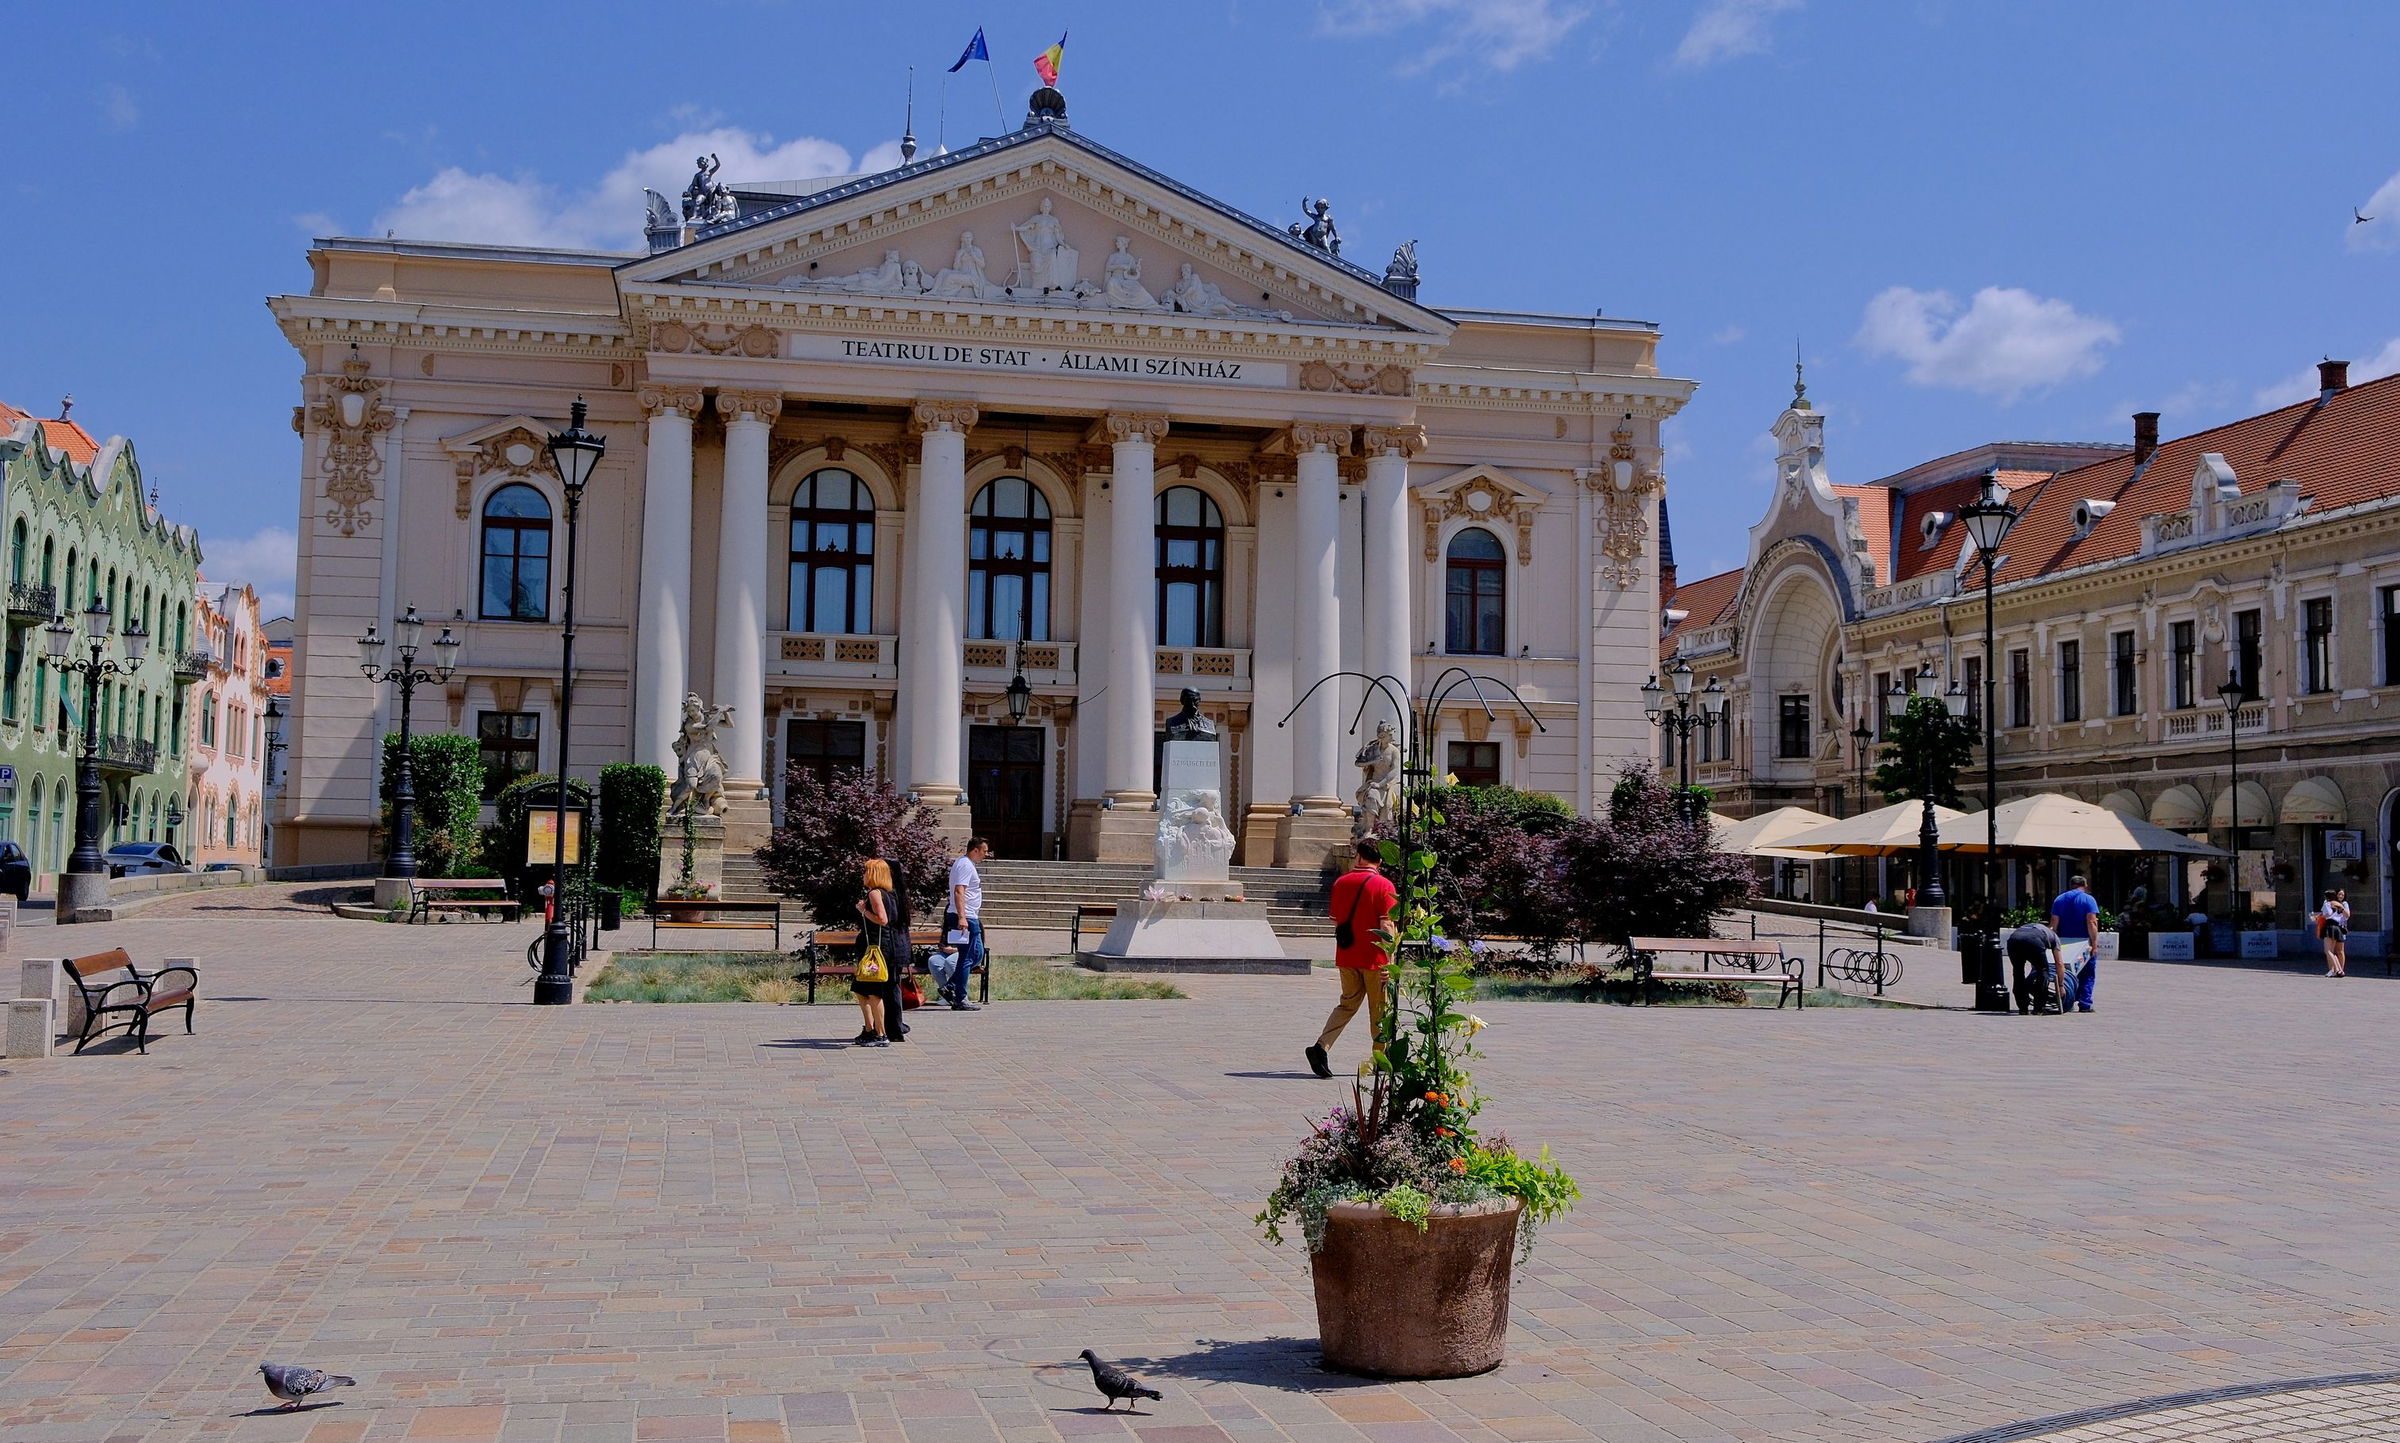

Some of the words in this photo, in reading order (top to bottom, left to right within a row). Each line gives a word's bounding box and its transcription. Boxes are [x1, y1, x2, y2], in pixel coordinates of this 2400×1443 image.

[841, 340, 940, 361] TEATRUL
[943, 346, 973, 363] DE
[979, 348, 1031, 366] STAT
[1059, 350, 1140, 373] ÁLLAMI
[1145, 356, 1242, 380] SZÍNHÁZ
[1, 769, 10, 779] P
